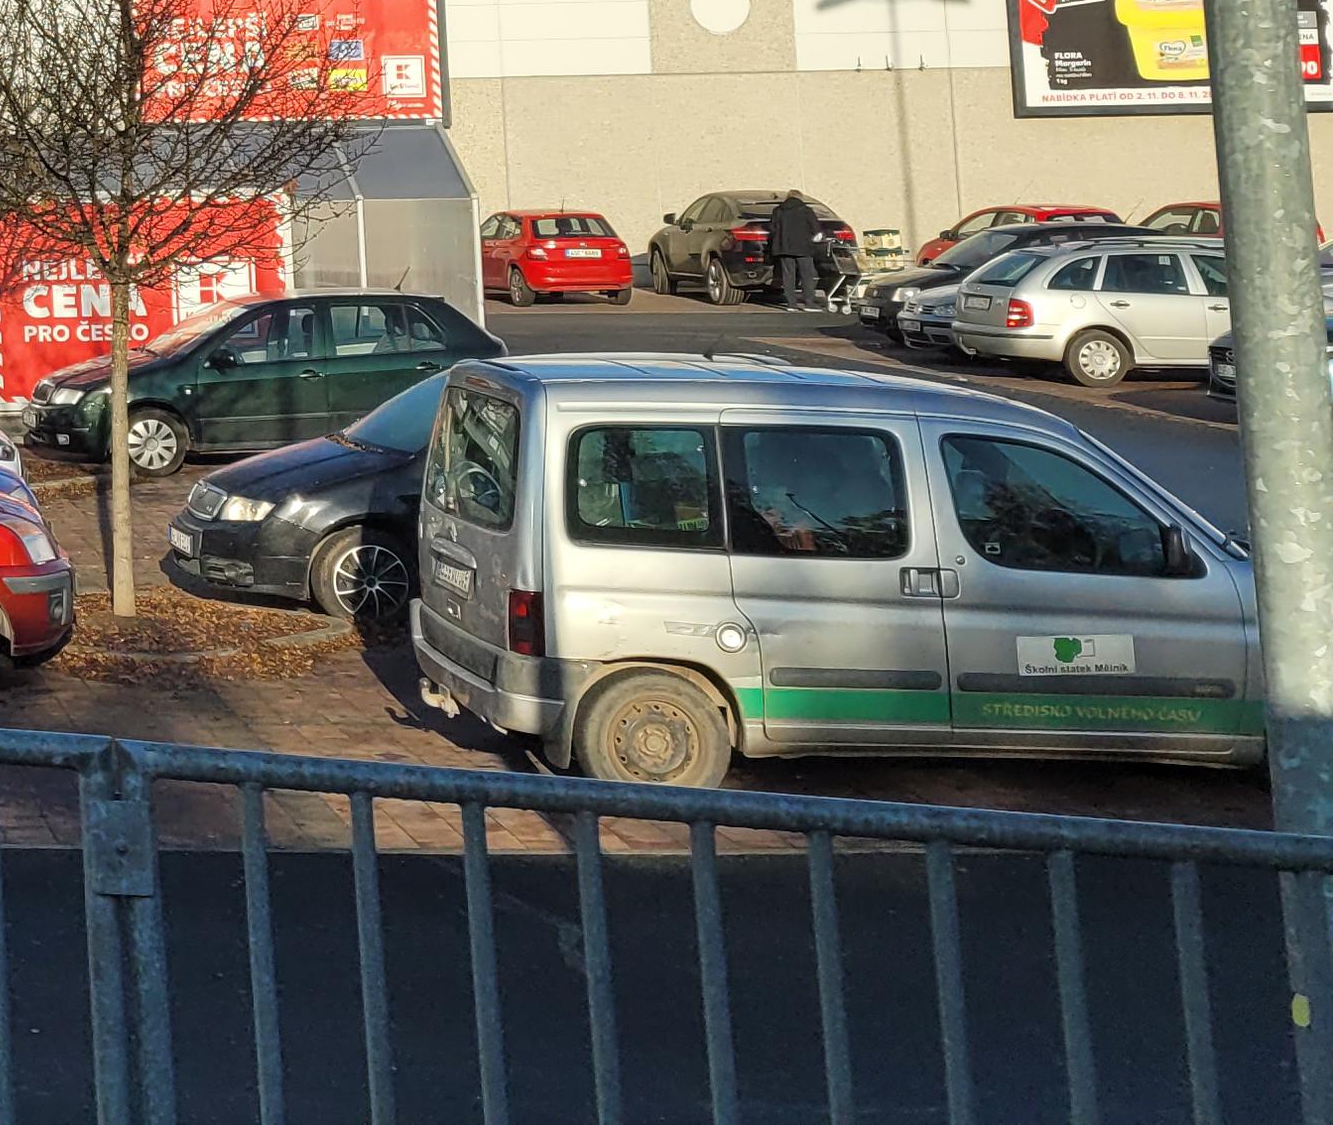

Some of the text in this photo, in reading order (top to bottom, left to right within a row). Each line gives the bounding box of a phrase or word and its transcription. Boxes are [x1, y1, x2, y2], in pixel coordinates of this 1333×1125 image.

[1054, 52, 1083, 60] FLORA
[1042, 93, 1087, 103] NABÍDKA
[1089, 91, 1117, 101] PLATÍ
[1119, 92, 1134, 100] OD
[1162, 91, 1176, 99] DO
[24, 320, 149, 342] PRO ČESO
[1024, 663, 1129, 675] Školní statek Mělník
[982, 702, 1072, 718] STŘEDISKO
[1075, 704, 1155, 721] VOLNÉHO
